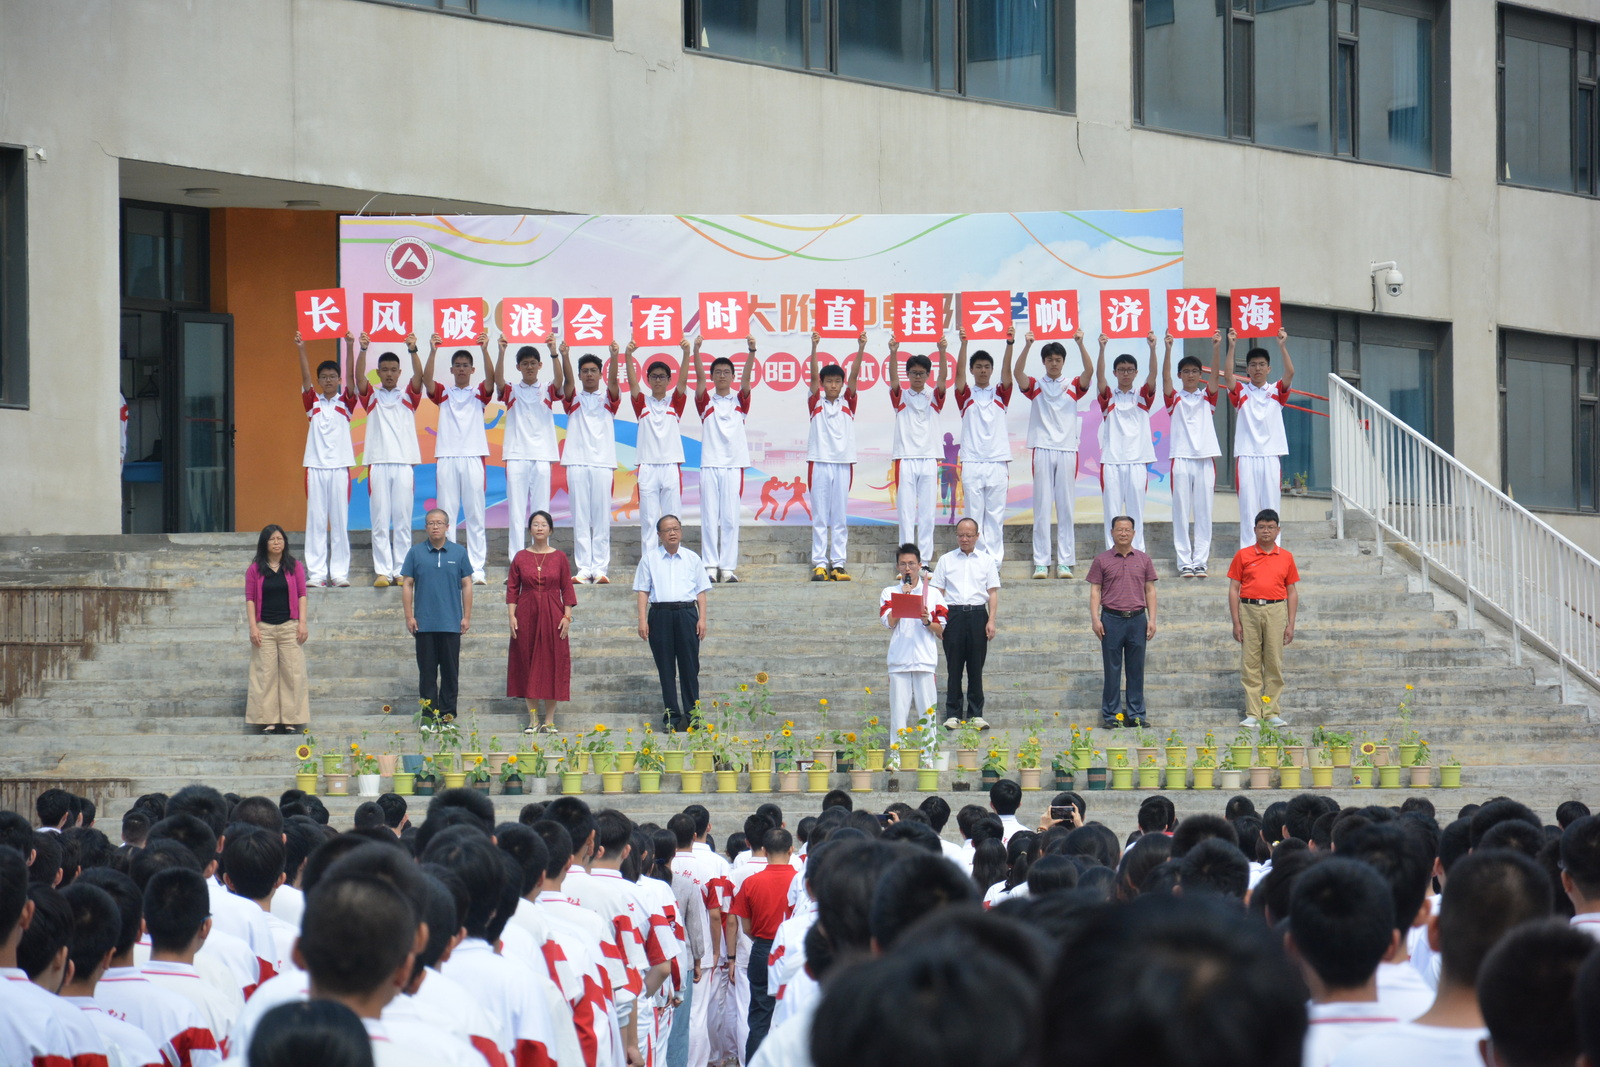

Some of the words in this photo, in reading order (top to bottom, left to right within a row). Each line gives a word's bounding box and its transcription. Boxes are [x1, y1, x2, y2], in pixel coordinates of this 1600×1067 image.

[303, 296, 341, 333] 长
[369, 299, 407, 336] 风
[440, 303, 478, 341] 破
[508, 302, 547, 338] 浪
[569, 303, 607, 341] 会
[639, 304, 675, 341] 有
[705, 297, 743, 334] 时
[821, 295, 858, 332] 直
[900, 299, 937, 337] 挂
[968, 297, 1005, 333] 云
[1035, 297, 1074, 334] 帆
[1106, 295, 1144, 333] 济
[1173, 295, 1211, 332] 沧
[1237, 294, 1275, 331] 海
